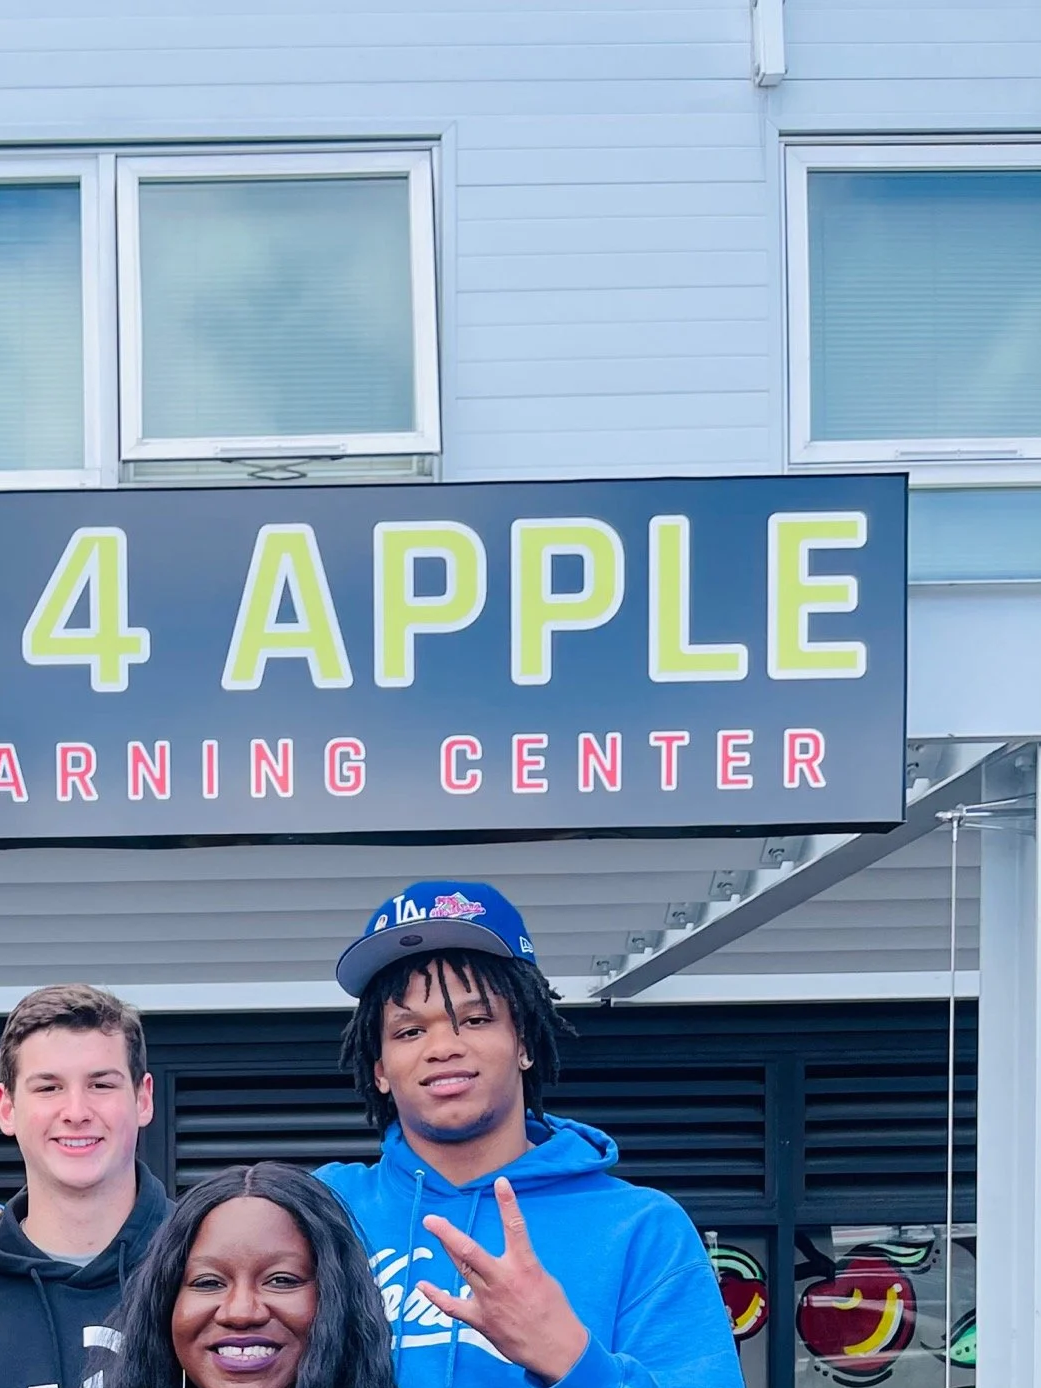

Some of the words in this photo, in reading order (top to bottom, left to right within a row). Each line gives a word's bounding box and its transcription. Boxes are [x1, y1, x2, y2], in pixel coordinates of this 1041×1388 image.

[22, 526, 150, 692] 4
[221, 511, 868, 691] APPLE
[440, 728, 827, 795] CENTER
